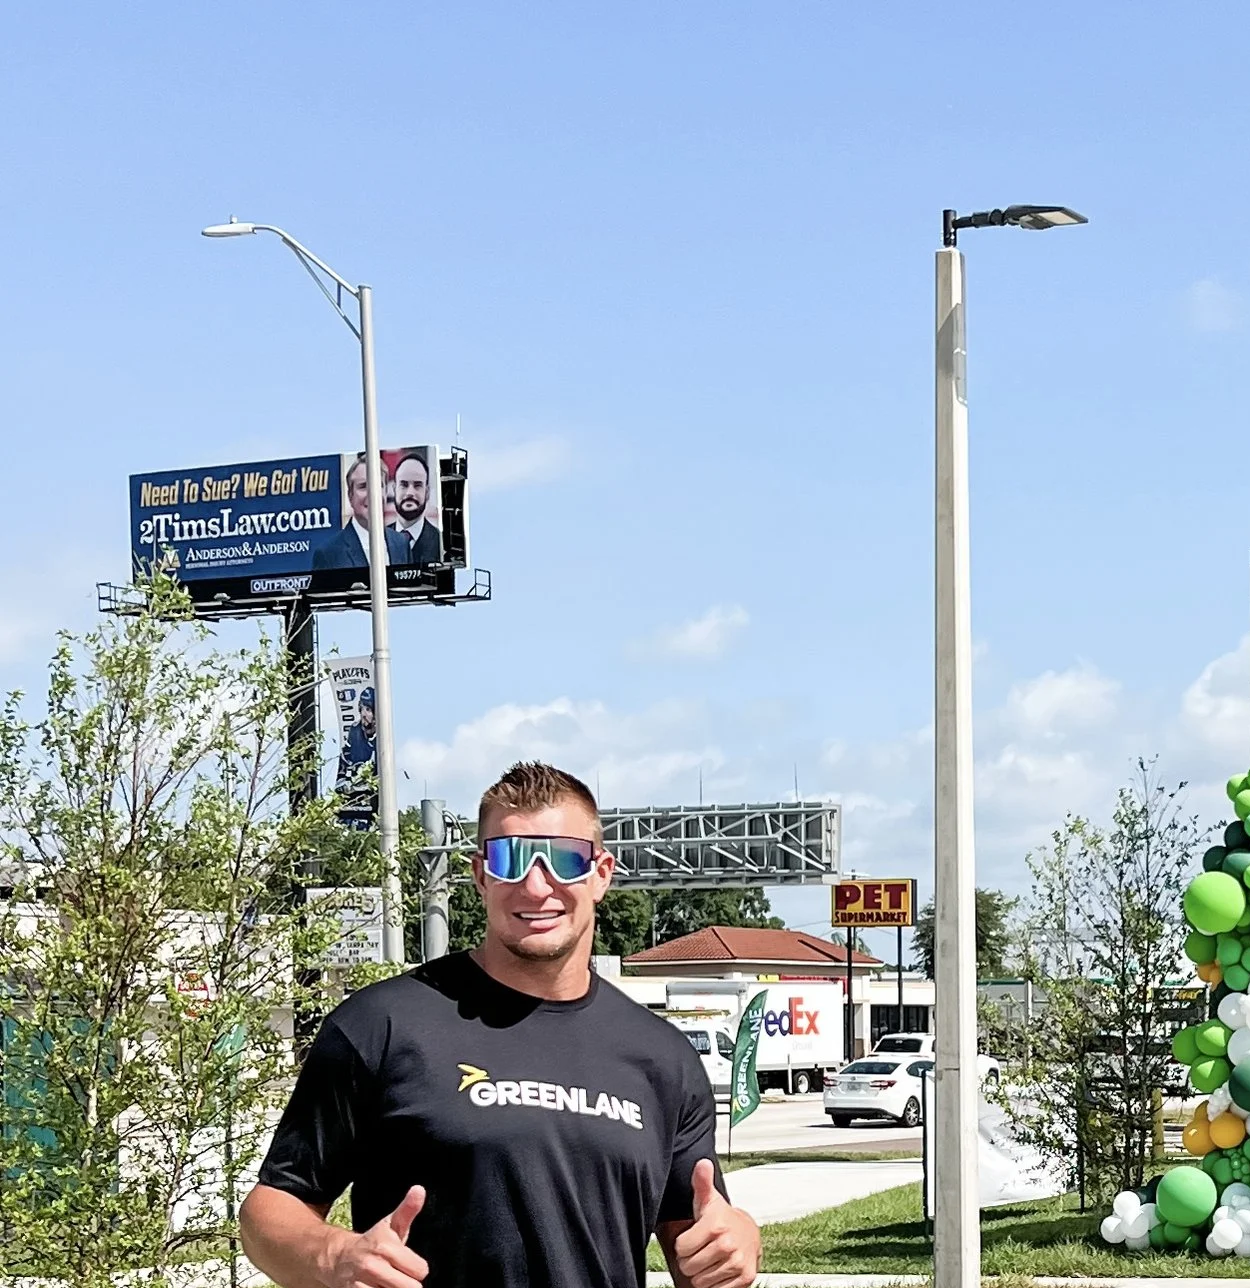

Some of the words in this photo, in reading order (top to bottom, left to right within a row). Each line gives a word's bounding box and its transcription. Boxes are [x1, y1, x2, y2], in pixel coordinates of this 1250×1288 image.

[140, 481, 180, 508] Need
[183, 478, 199, 504] To
[202, 473, 240, 502] Sue?
[243, 471, 268, 499] We
[270, 468, 298, 496] Got
[301, 465, 329, 493] You
[139, 507, 332, 544] 2TimsLaw.com
[253, 577, 309, 592] OUTFRONT
[835, 883, 907, 910] PET
[835, 911, 907, 923] SUPERMARKET
[761, 996, 820, 1037] edEx
[469, 1080, 644, 1130] GREENLANE
